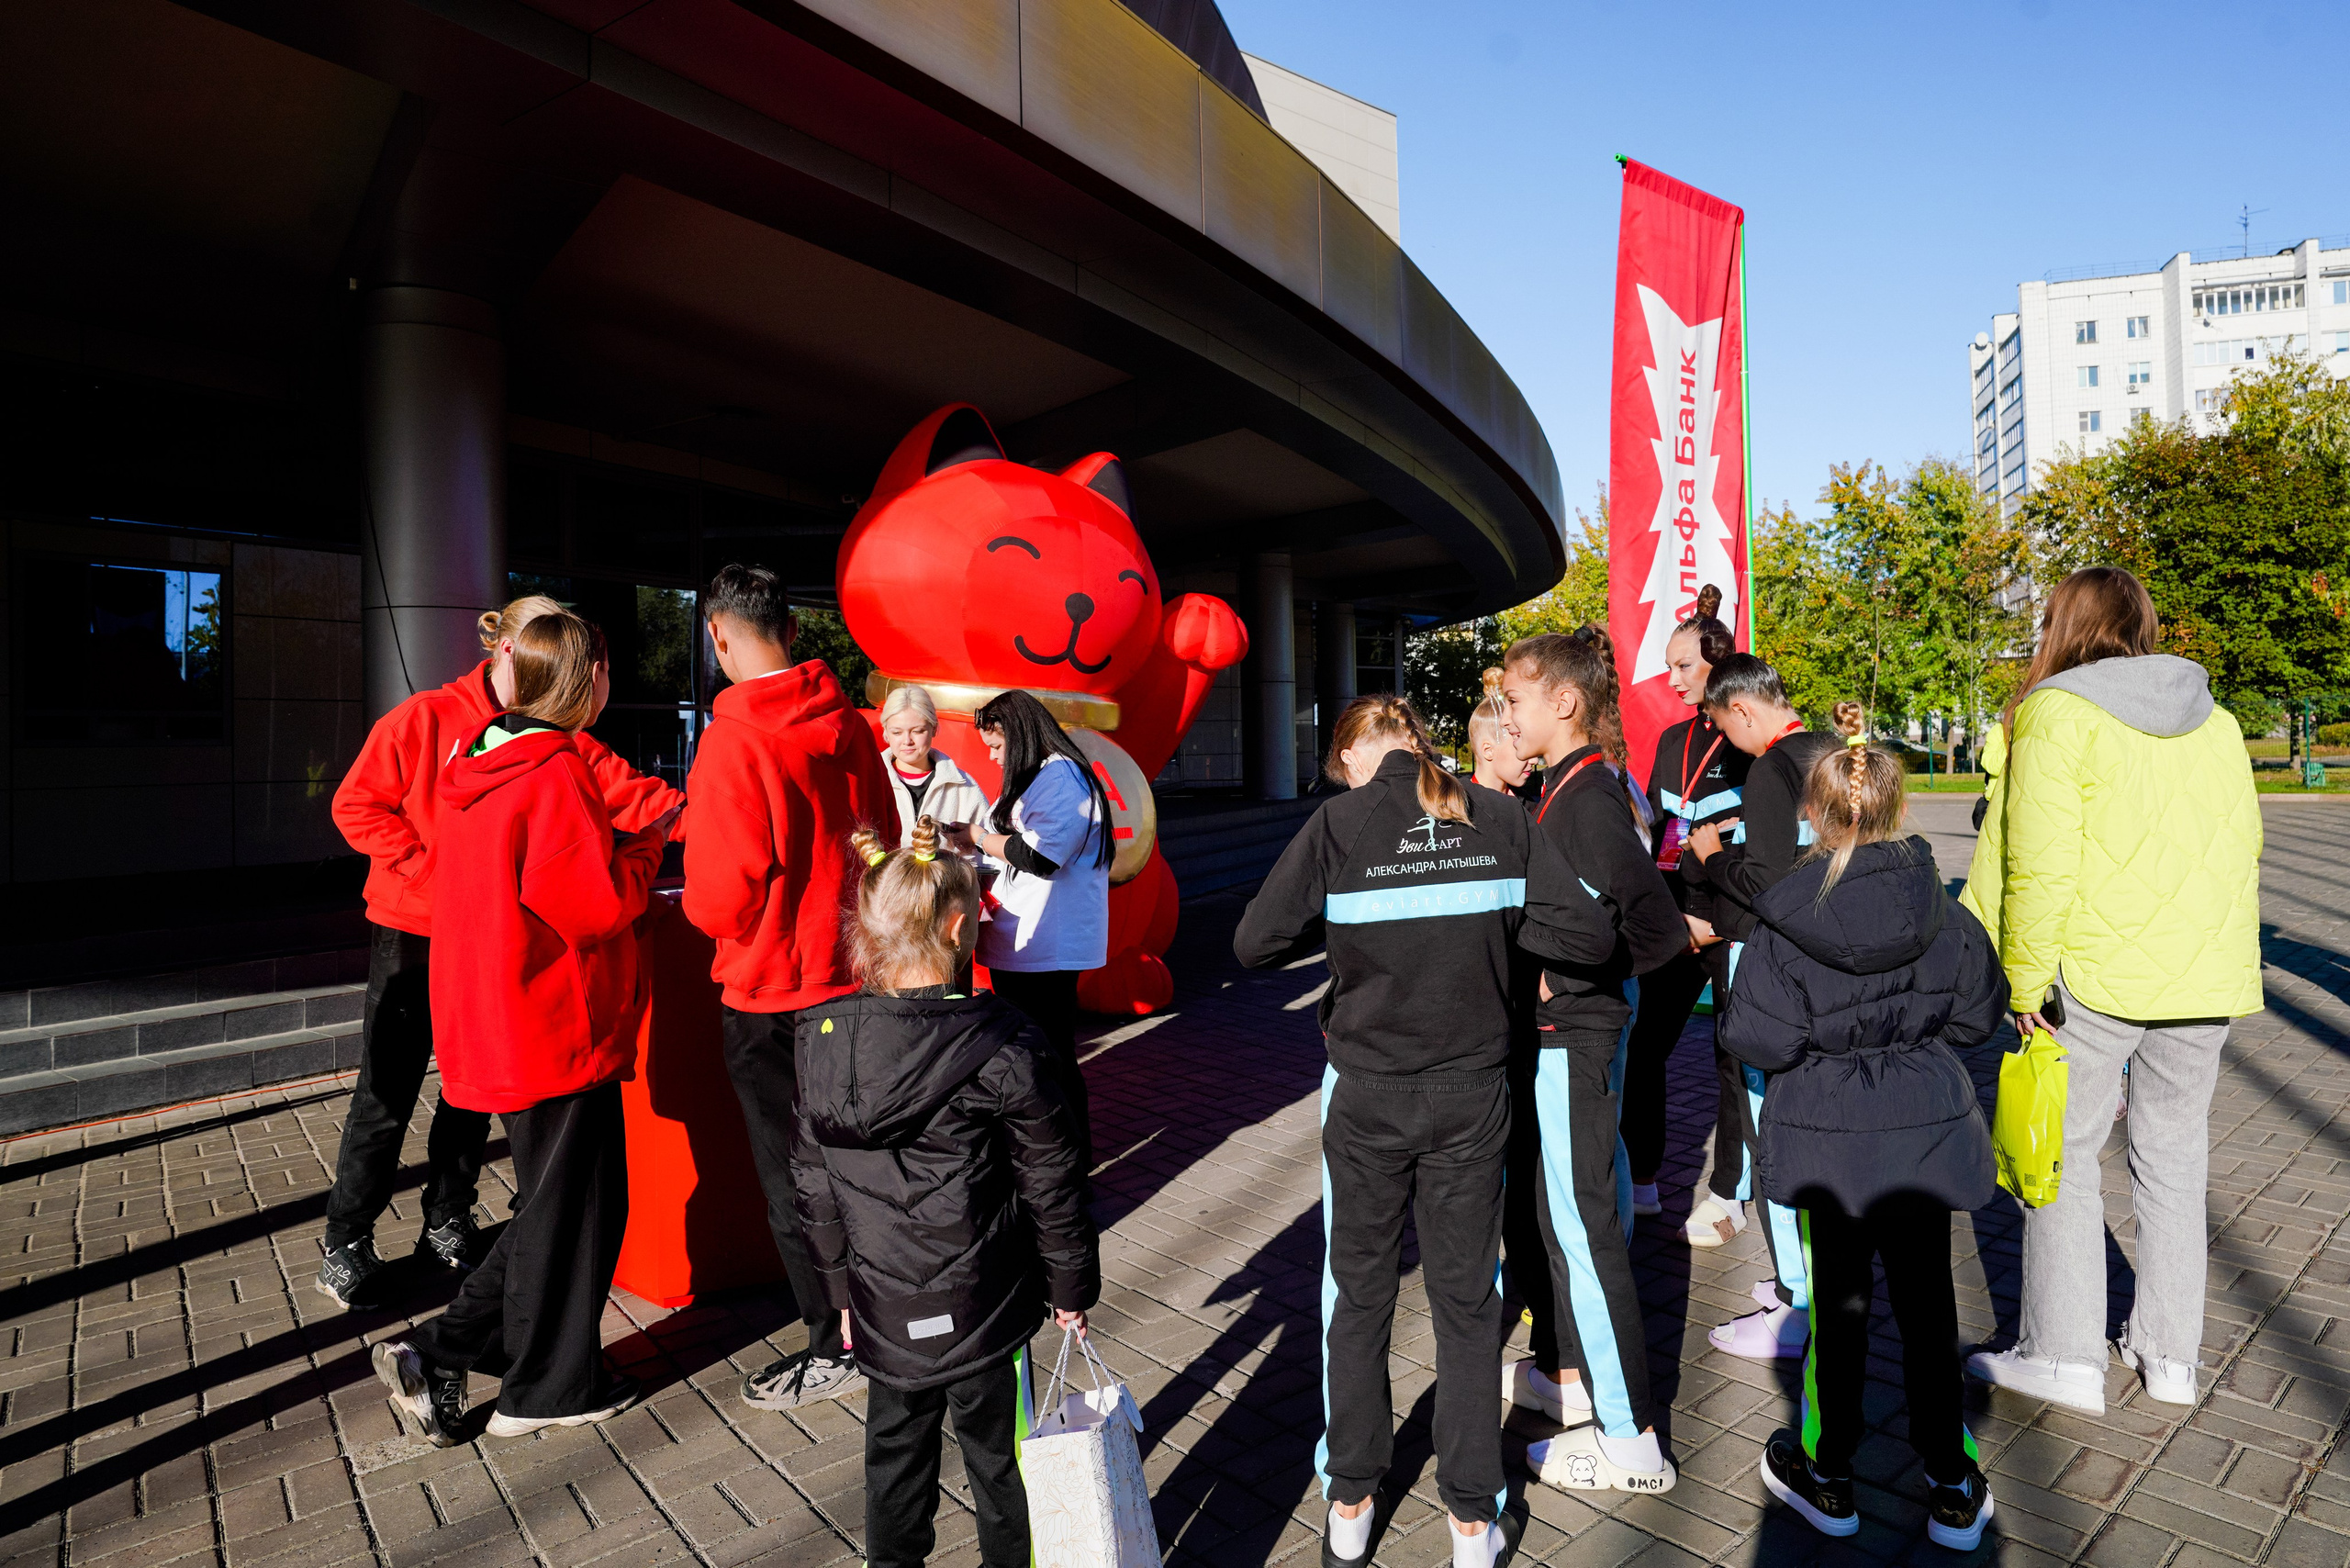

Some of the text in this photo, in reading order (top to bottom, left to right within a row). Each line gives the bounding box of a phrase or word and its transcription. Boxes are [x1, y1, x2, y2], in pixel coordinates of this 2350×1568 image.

[1673, 345, 1700, 624] Альфа Банк
[1366, 856, 1497, 878] АЛЕКСАНДРА ЛАТЫШЕВА
